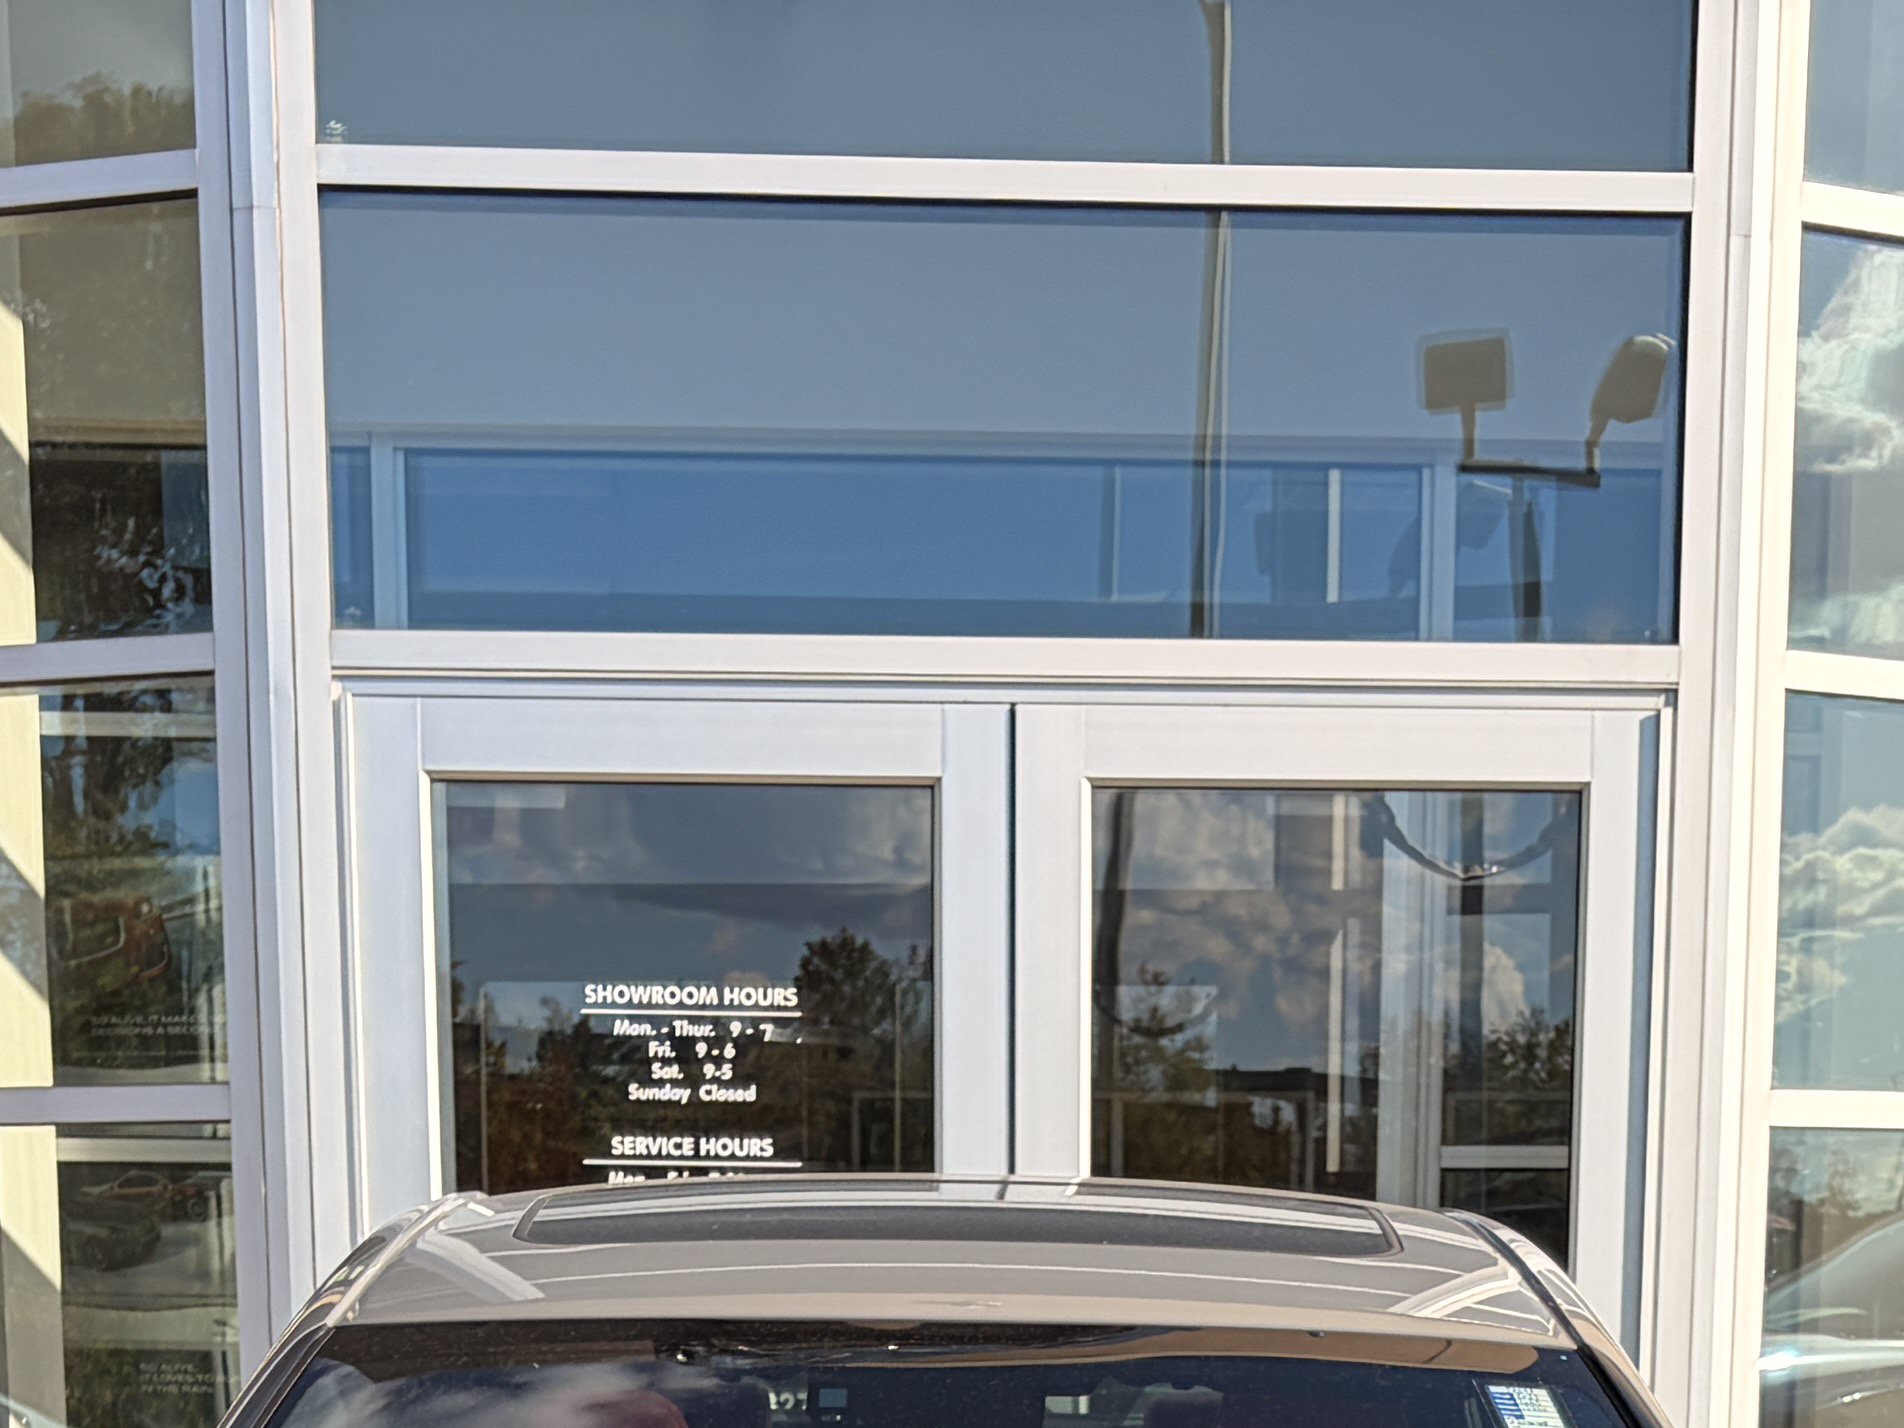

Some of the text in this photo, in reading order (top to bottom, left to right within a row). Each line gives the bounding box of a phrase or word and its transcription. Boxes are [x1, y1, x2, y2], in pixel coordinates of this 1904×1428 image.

[584, 984, 799, 1007] SHOWROOM HOURS
[612, 1018, 657, 1036] Mon.
[672, 1019, 716, 1037] Thur.
[729, 1020, 743, 1038] 9
[759, 1023, 775, 1042] 7
[648, 1040, 676, 1058] Fri.
[695, 1041, 708, 1059] 9
[723, 1042, 736, 1059] 6
[651, 1062, 684, 1080] Sat.
[628, 1083, 757, 1105] Sunday Closed
[611, 1136, 774, 1158] SERVICE HOURS
